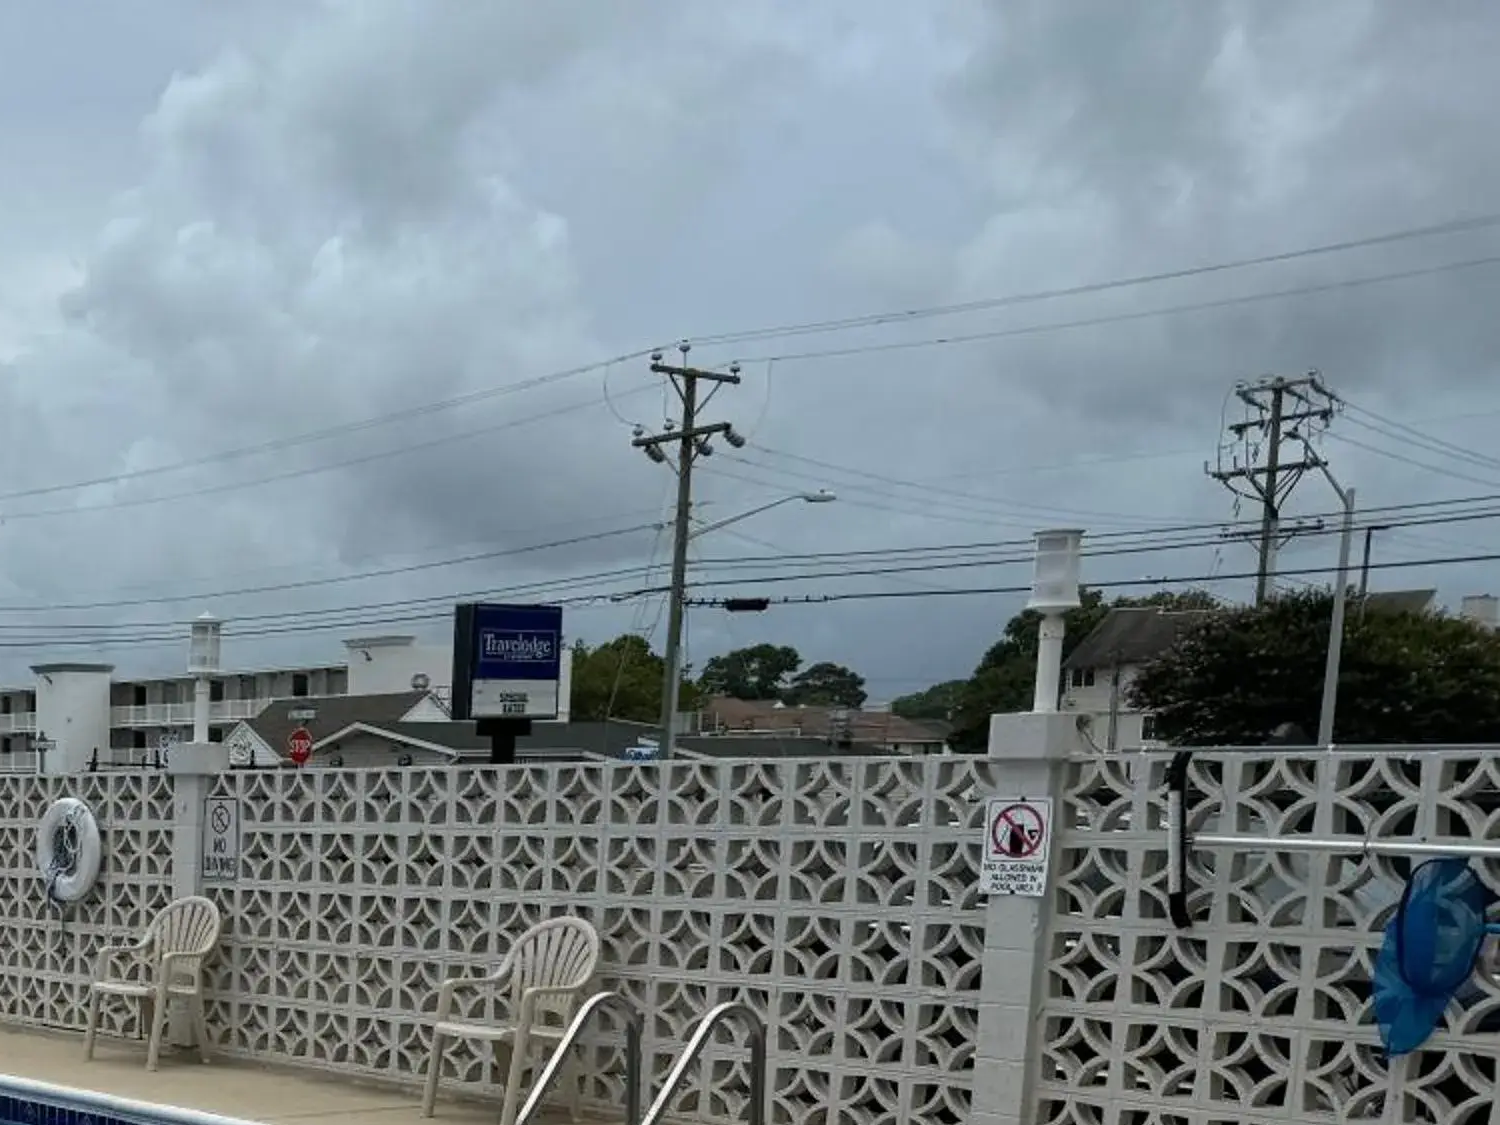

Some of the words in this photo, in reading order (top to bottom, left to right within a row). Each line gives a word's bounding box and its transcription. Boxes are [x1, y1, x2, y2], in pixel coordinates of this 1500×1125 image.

[484, 632, 552, 658] Travelodge
[290, 739, 310, 752] STOP
[213, 837, 227, 853] NO
